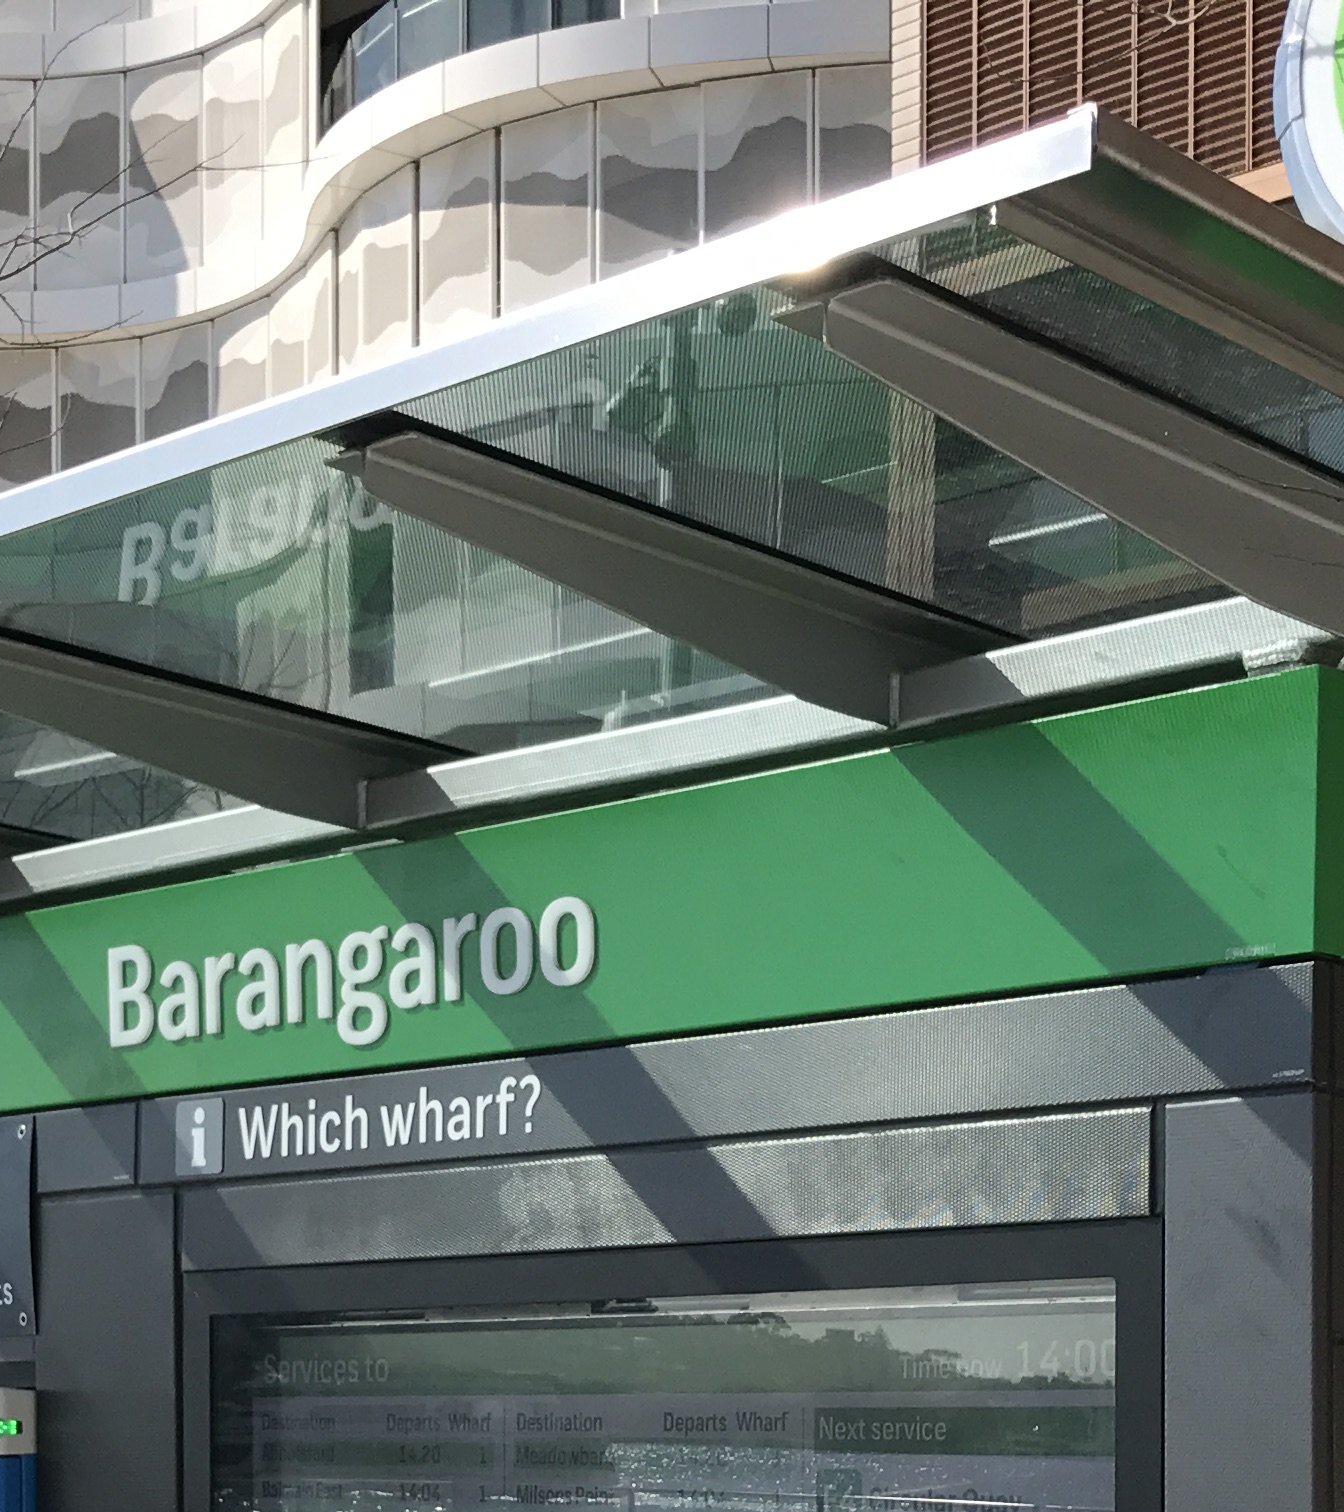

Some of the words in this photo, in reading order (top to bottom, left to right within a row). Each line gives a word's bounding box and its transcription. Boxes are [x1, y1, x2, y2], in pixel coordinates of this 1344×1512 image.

[106, 895, 597, 1049] Barangaroo
[237, 1094, 369, 1161] Which
[379, 1074, 543, 1148] wharf?
[262, 1354, 359, 1385] Services
[364, 1355, 390, 1385] to
[516, 1412, 604, 1433] Destination
[662, 1411, 728, 1436] Departs
[735, 1410, 789, 1433] Wharf
[818, 1416, 866, 1441] Next
[871, 1416, 948, 1441] service
